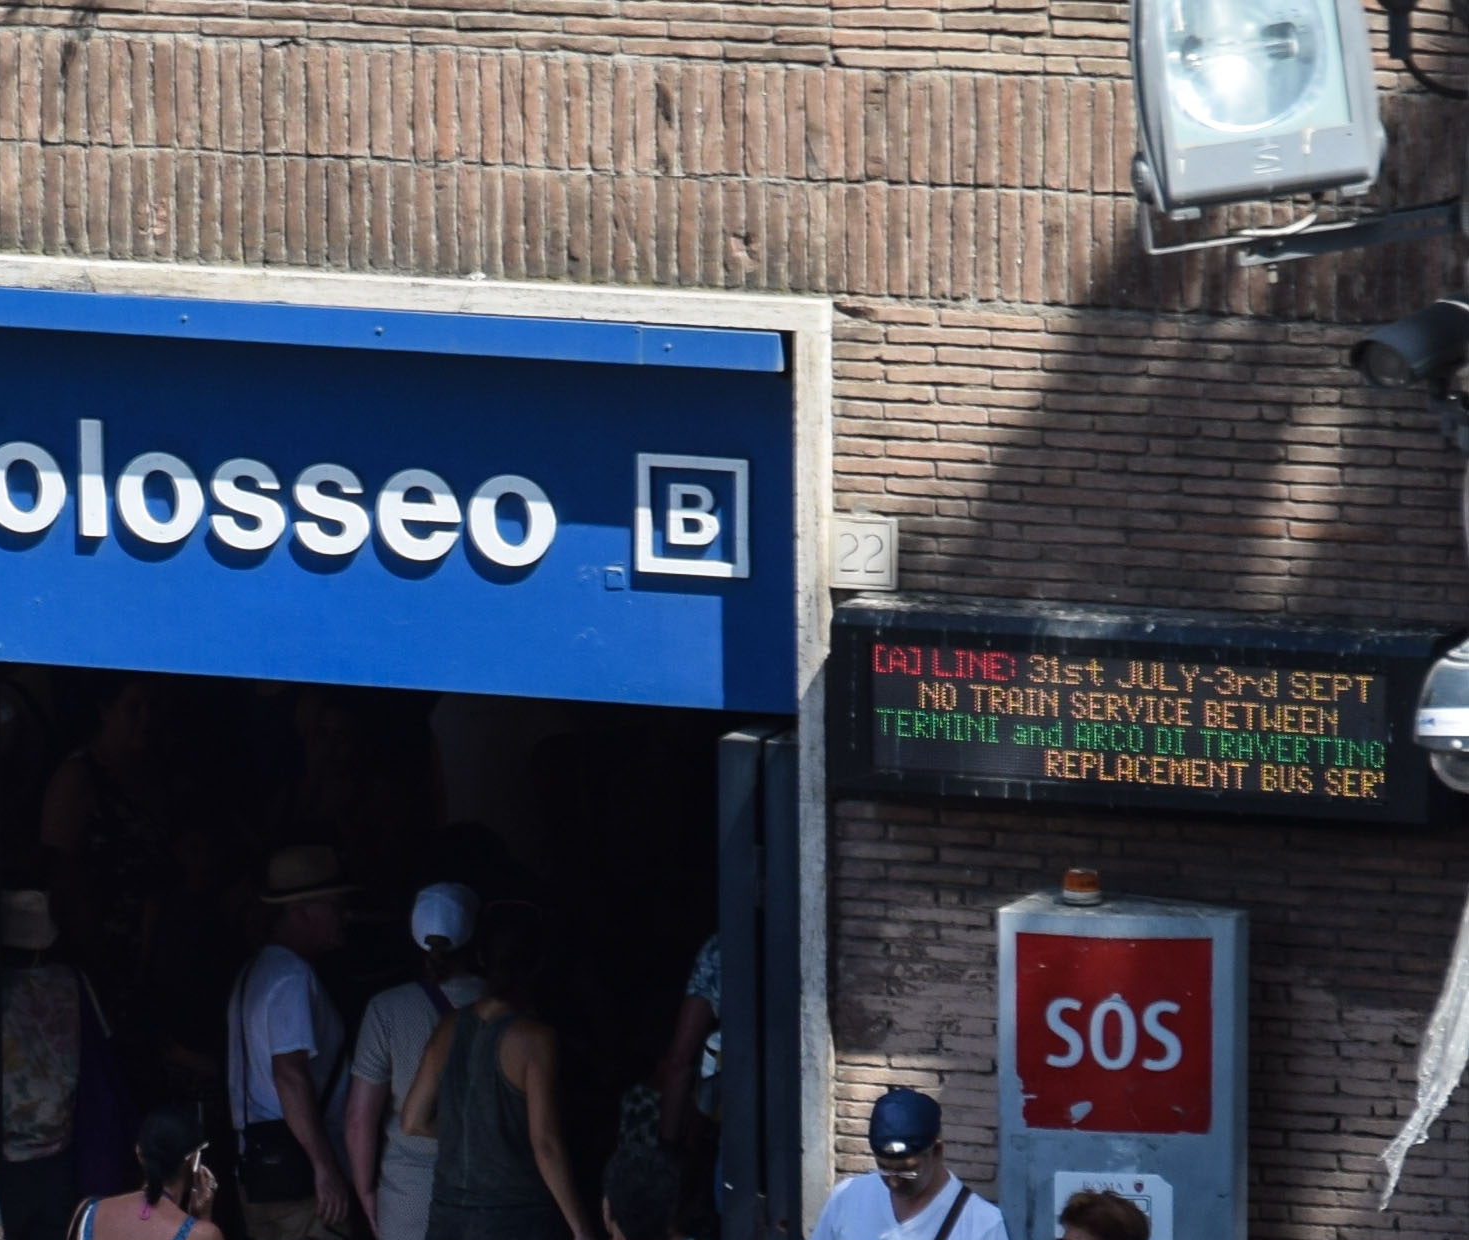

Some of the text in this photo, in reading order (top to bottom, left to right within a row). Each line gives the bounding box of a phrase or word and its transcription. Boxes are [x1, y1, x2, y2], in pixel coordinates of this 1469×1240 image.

[665, 482, 719, 548] B
[838, 532, 885, 574] 22
[1027, 653, 1105, 687] 31st
[1289, 671, 1374, 703] SEPT
[917, 680, 1339, 736] NO TRAIN SERVICE BETWEEN
[874, 707, 1385, 768] TERMINI and ARCO DI TRAVERTINO
[1044, 750, 1385, 798] REPLACEMENT BUS SER
[1044, 997, 1184, 1072] SOS
